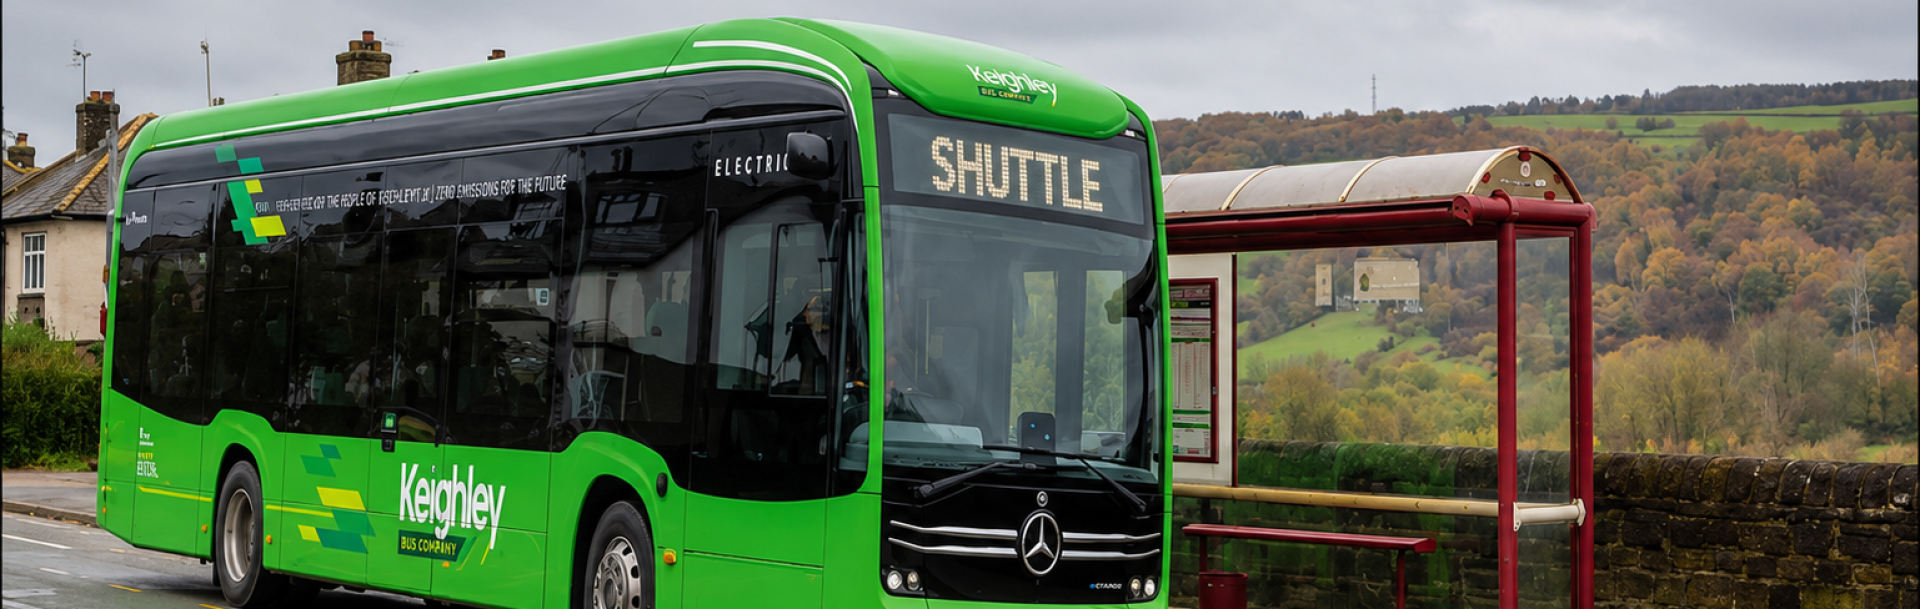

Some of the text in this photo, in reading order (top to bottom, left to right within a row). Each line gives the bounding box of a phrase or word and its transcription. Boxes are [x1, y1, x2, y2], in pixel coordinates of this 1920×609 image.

[966, 64, 1057, 107] Keighley
[365, 191, 377, 206] OF
[517, 177, 533, 194] THE
[932, 136, 1103, 212] SHUTTLE
[399, 462, 506, 550] Keighley
[401, 536, 417, 551] BUS
